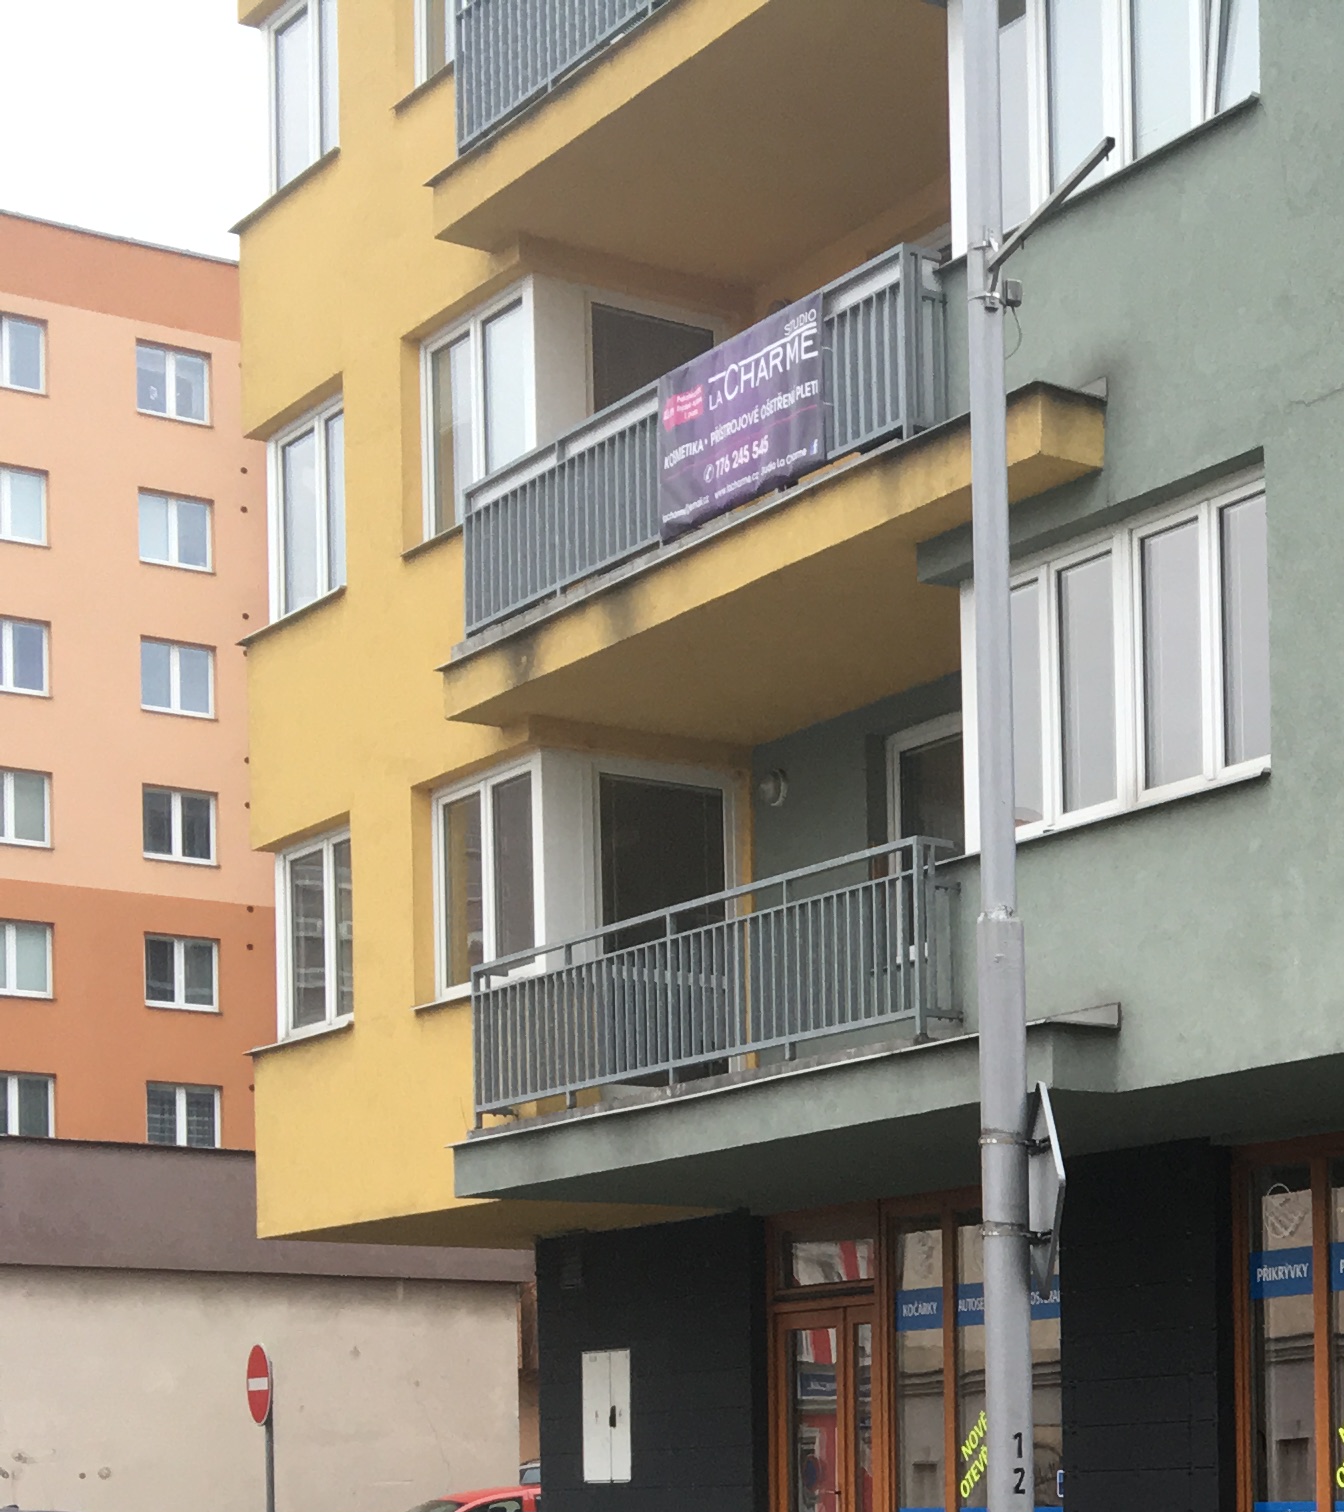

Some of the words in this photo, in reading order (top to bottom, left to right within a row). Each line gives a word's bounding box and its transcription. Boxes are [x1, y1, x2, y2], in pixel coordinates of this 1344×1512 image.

[784, 309, 817, 335] STUDIO
[709, 390, 723, 411] LA
[724, 328, 819, 401] CHARME
[664, 438, 704, 469] KOSMETIKA
[796, 380, 819, 401] PLETI
[732, 445, 749, 469] 245
[752, 435, 769, 459] 545
[1257, 1262, 1309, 1283] PŘIKRÝVKY
[902, 1301, 938, 1317] KOČÁRKY
